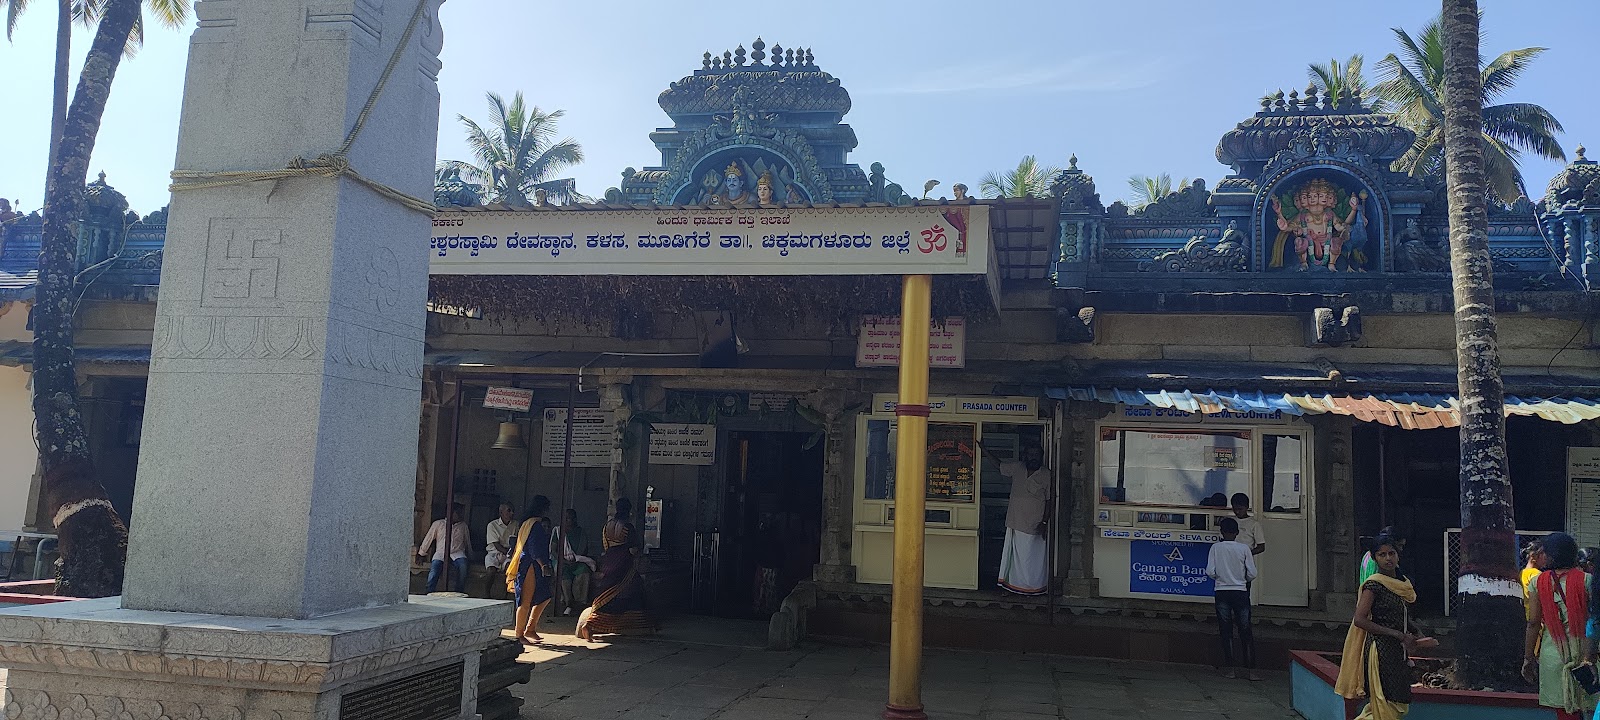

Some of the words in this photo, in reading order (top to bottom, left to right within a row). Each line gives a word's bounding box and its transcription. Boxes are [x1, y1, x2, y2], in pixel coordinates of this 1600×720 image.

[656, 215, 689, 226] ಹಿಂದೂ
[693, 215, 733, 227] ಧಾರ್ಮಿಕ
[738, 214, 755, 229] ದತ್ತಿ
[506, 231, 577, 258] ದೇವಸ್ಥಾನ,
[586, 231, 629, 249] ಕಳಸ,
[637, 230, 711, 249] ಮೂಡಿಗೆರೆ
[761, 230, 872, 257] ಚಿಕ್ಕಮಗಳೂರು
[881, 230, 911, 255] ಜಿಲ್ಲೆ
[962, 402, 993, 411] PRASADA
[995, 403, 1028, 412] COUNTER
[1103, 528, 1131, 538] ಸೇವಾ
[1133, 529, 1172, 539] ಕೌಂಟರ್
[1179, 533, 1202, 542] SEVA
[1132, 562, 1177, 574] Canara
[1181, 565, 1207, 576] Ban
[1138, 572, 1167, 582] ಕೆನರಾ
[1170, 575, 1208, 587] ಬ್ಯಾಂಕ್
